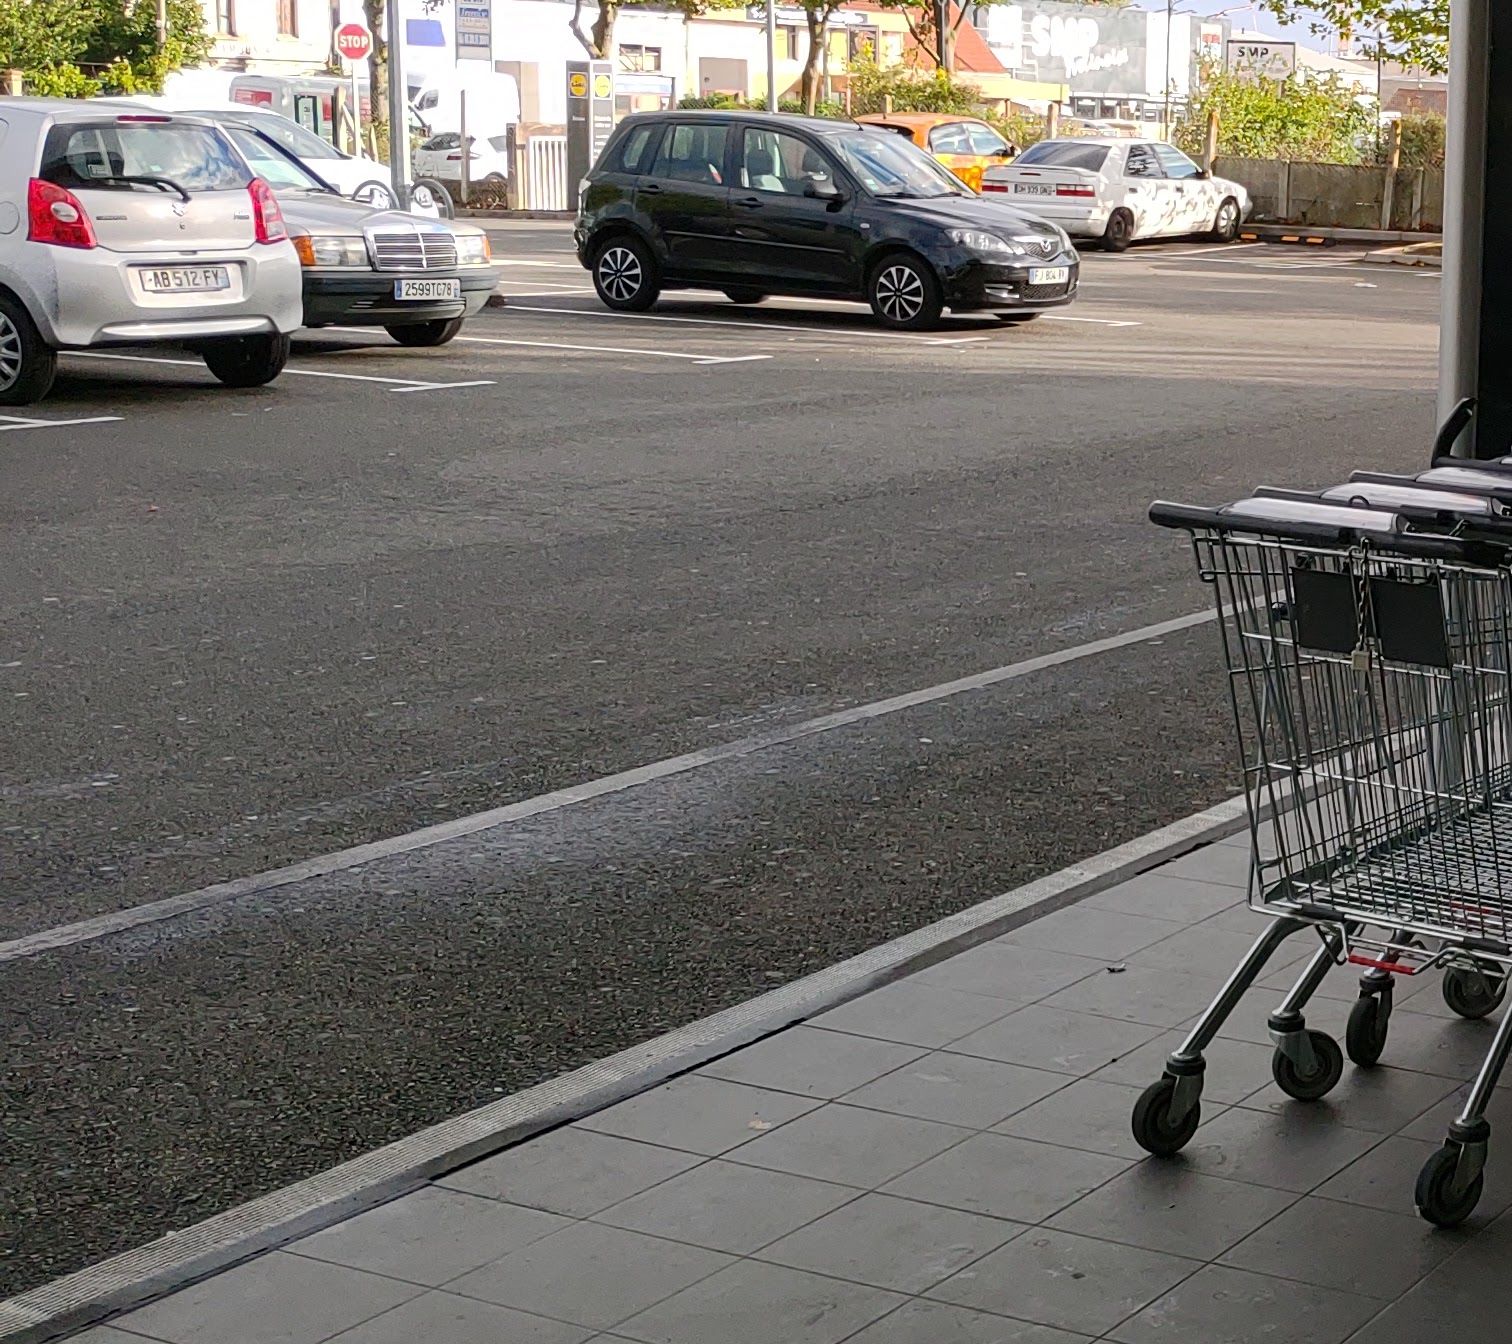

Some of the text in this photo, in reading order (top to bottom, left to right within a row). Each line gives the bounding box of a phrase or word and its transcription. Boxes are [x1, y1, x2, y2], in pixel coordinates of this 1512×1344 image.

[339, 34, 369, 49] STOP
[1237, 46, 1269, 58] SMP
[404, 282, 452, 296] 2599TC78
